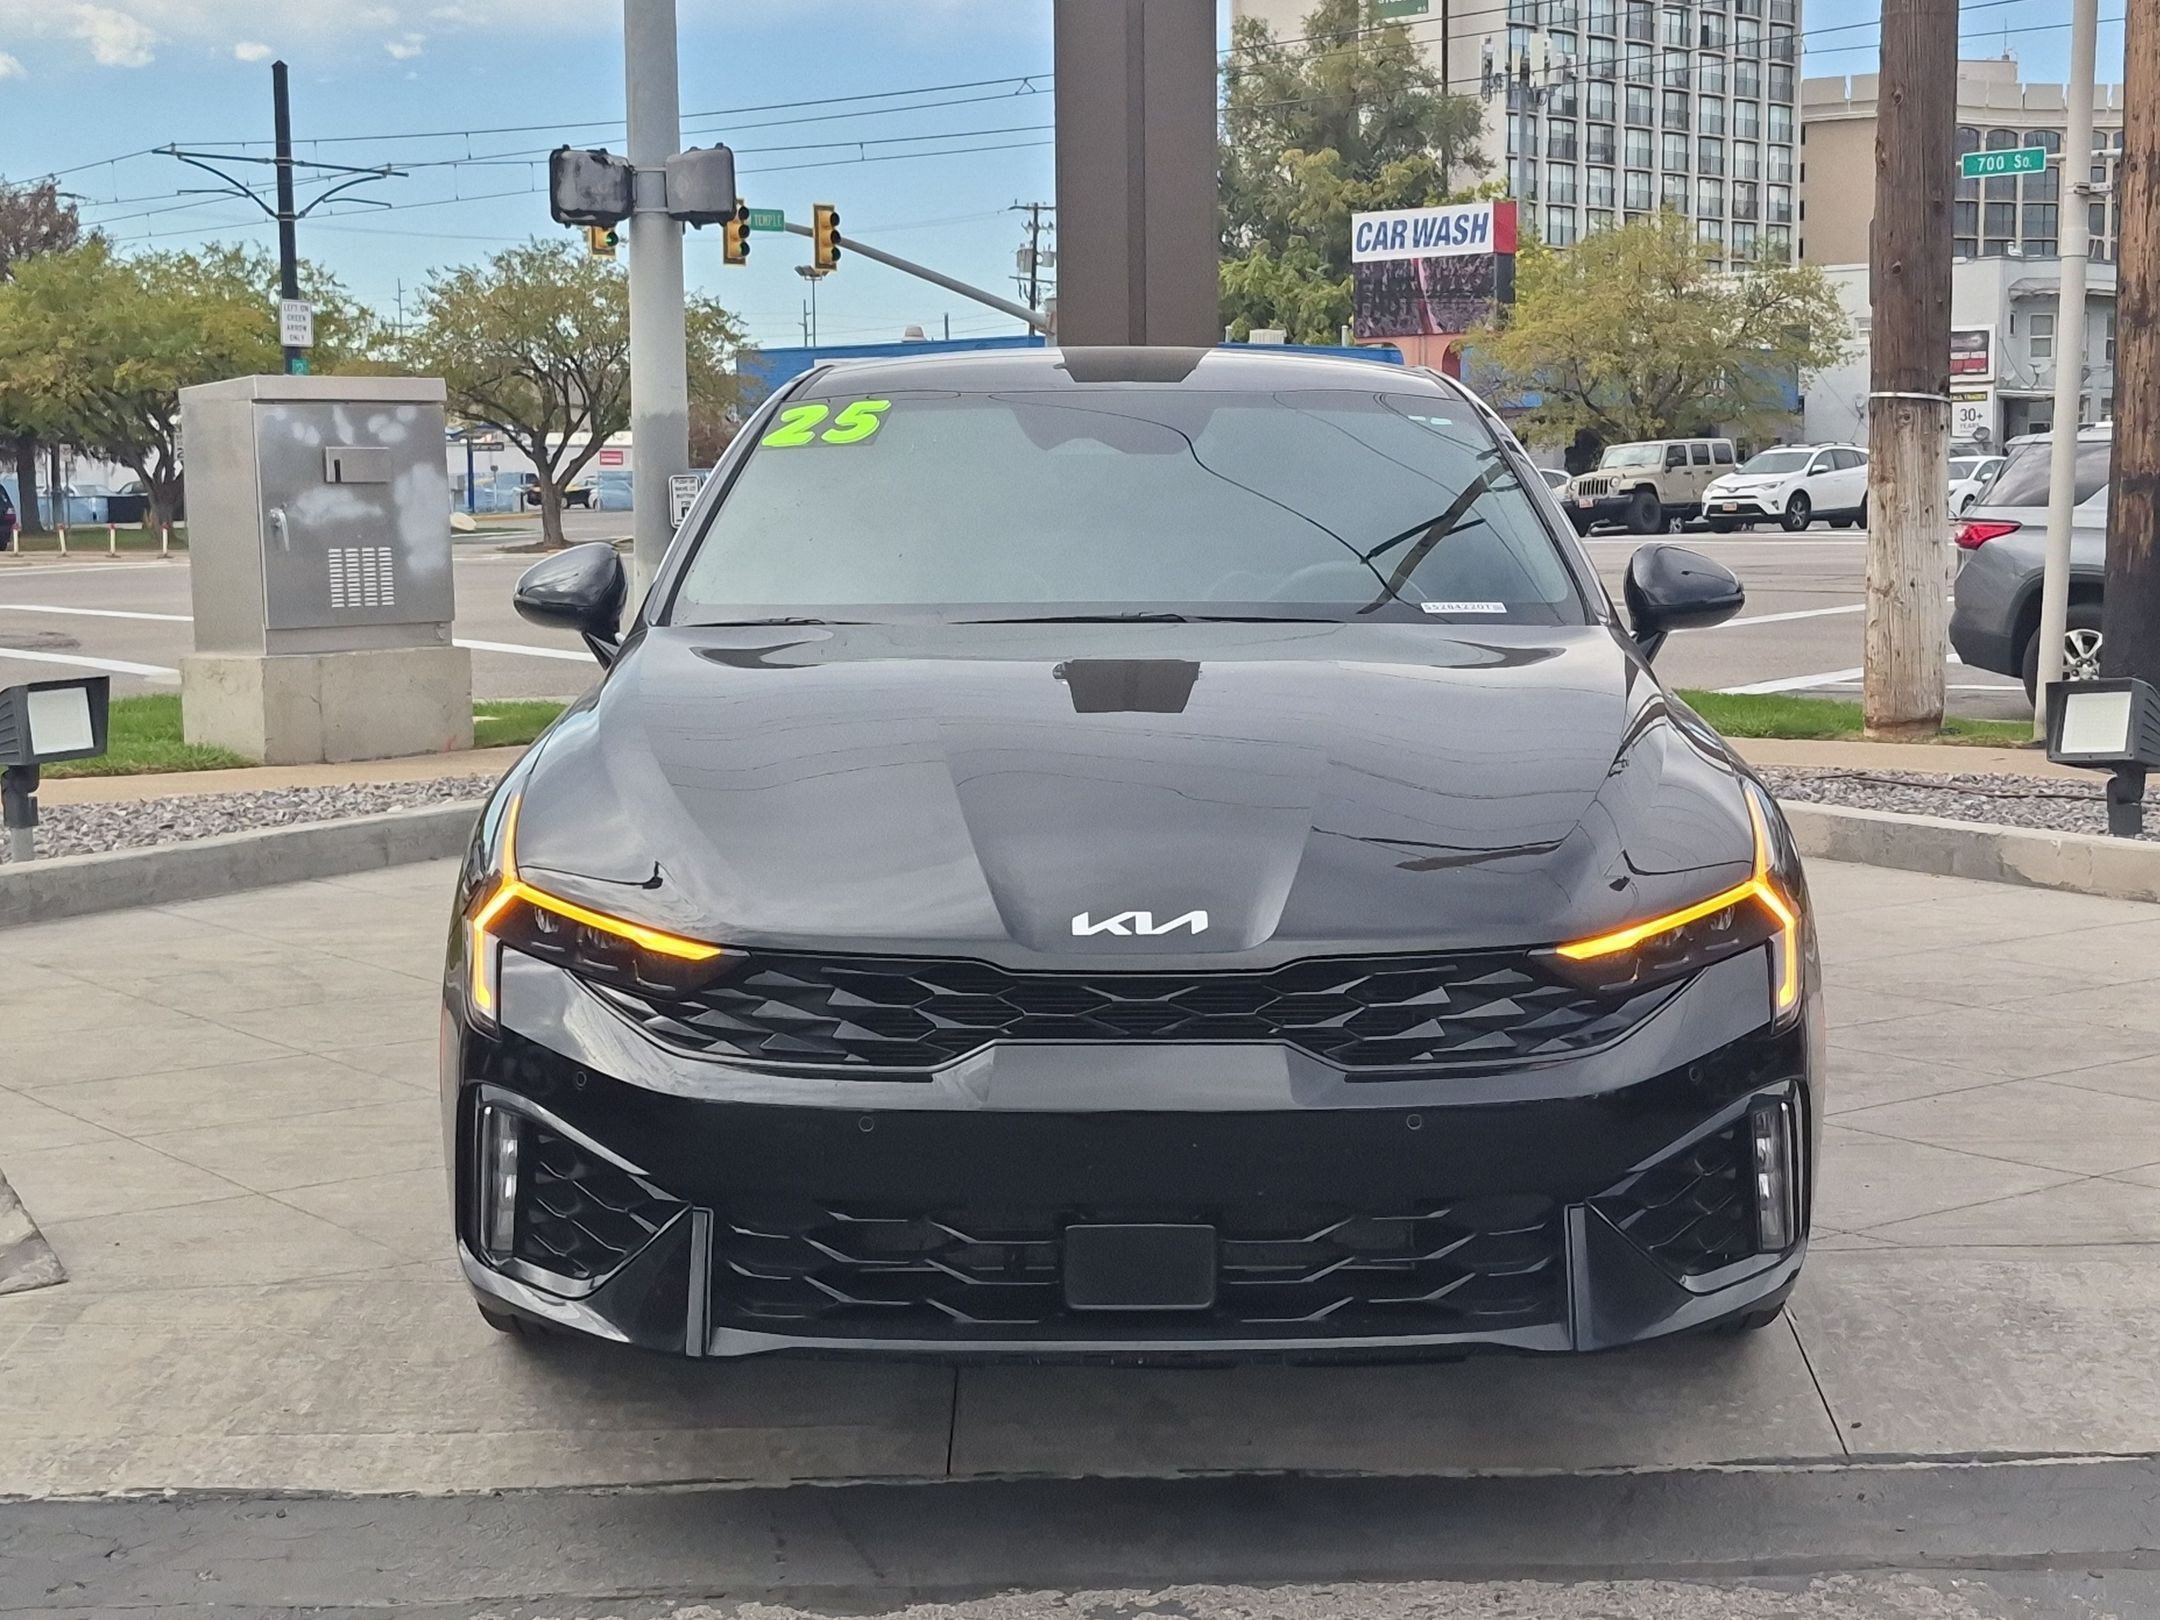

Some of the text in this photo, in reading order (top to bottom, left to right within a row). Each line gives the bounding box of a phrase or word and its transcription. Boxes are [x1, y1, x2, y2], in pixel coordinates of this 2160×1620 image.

[1977, 153, 2032, 173] 700 So.
[1356, 212, 1489, 253] CAR WASH
[284, 304, 309, 313] LEFT ON
[286, 314, 307, 322] GREEN
[286, 324, 308, 333] ARROW
[289, 334, 305, 342] ONLY
[1960, 407, 1984, 422] 30+
[761, 400, 892, 447] 25
[1072, 910, 1208, 936] KIA
